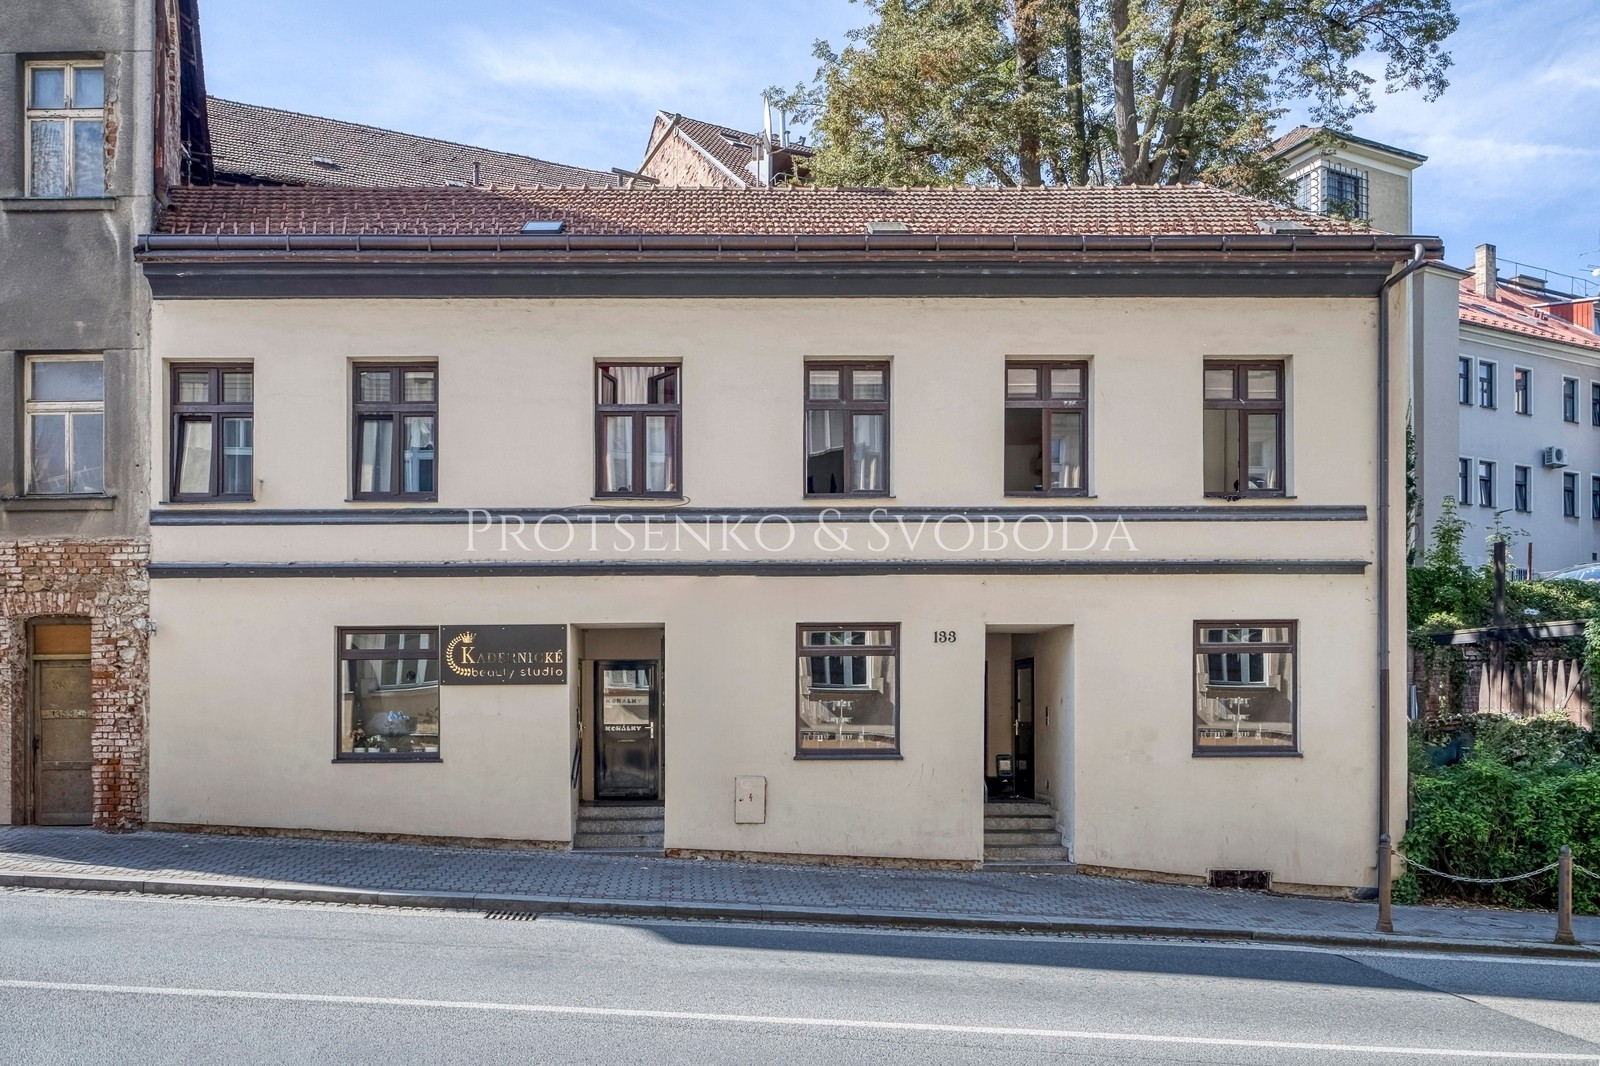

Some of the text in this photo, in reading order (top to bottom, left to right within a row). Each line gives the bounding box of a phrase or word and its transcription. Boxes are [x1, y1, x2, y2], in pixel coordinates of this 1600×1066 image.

[934, 630, 956, 643] 133
[472, 666, 563, 679] beauty studio
